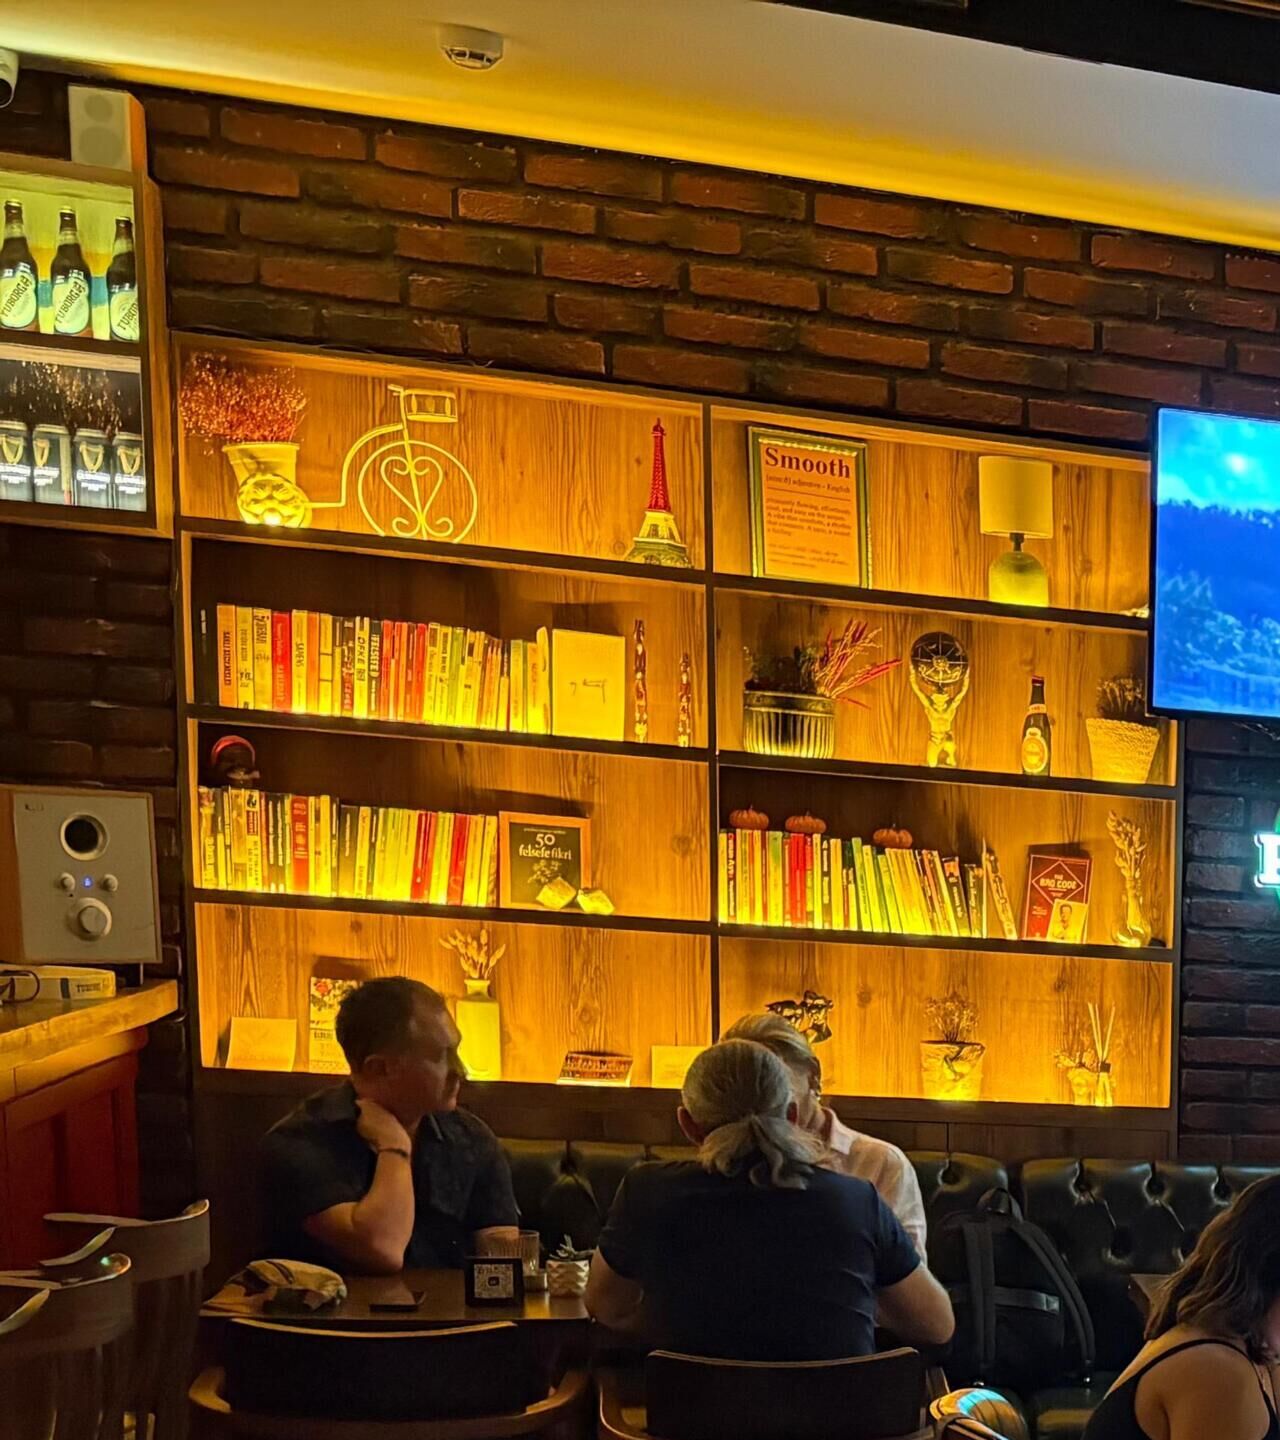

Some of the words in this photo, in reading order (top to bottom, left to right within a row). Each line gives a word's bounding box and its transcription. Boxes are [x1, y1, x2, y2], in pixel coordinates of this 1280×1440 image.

[0, 281, 27, 318] TUBORG
[55, 288, 79, 325] TUBORG
[765, 446, 850, 479] Smooth
[519, 844, 550, 858] felsefe
[551, 847, 572, 860] fikri
[535, 833, 555, 848] 50
[1040, 878, 1055, 887] BRO
[1057, 880, 1076, 889] CODE
